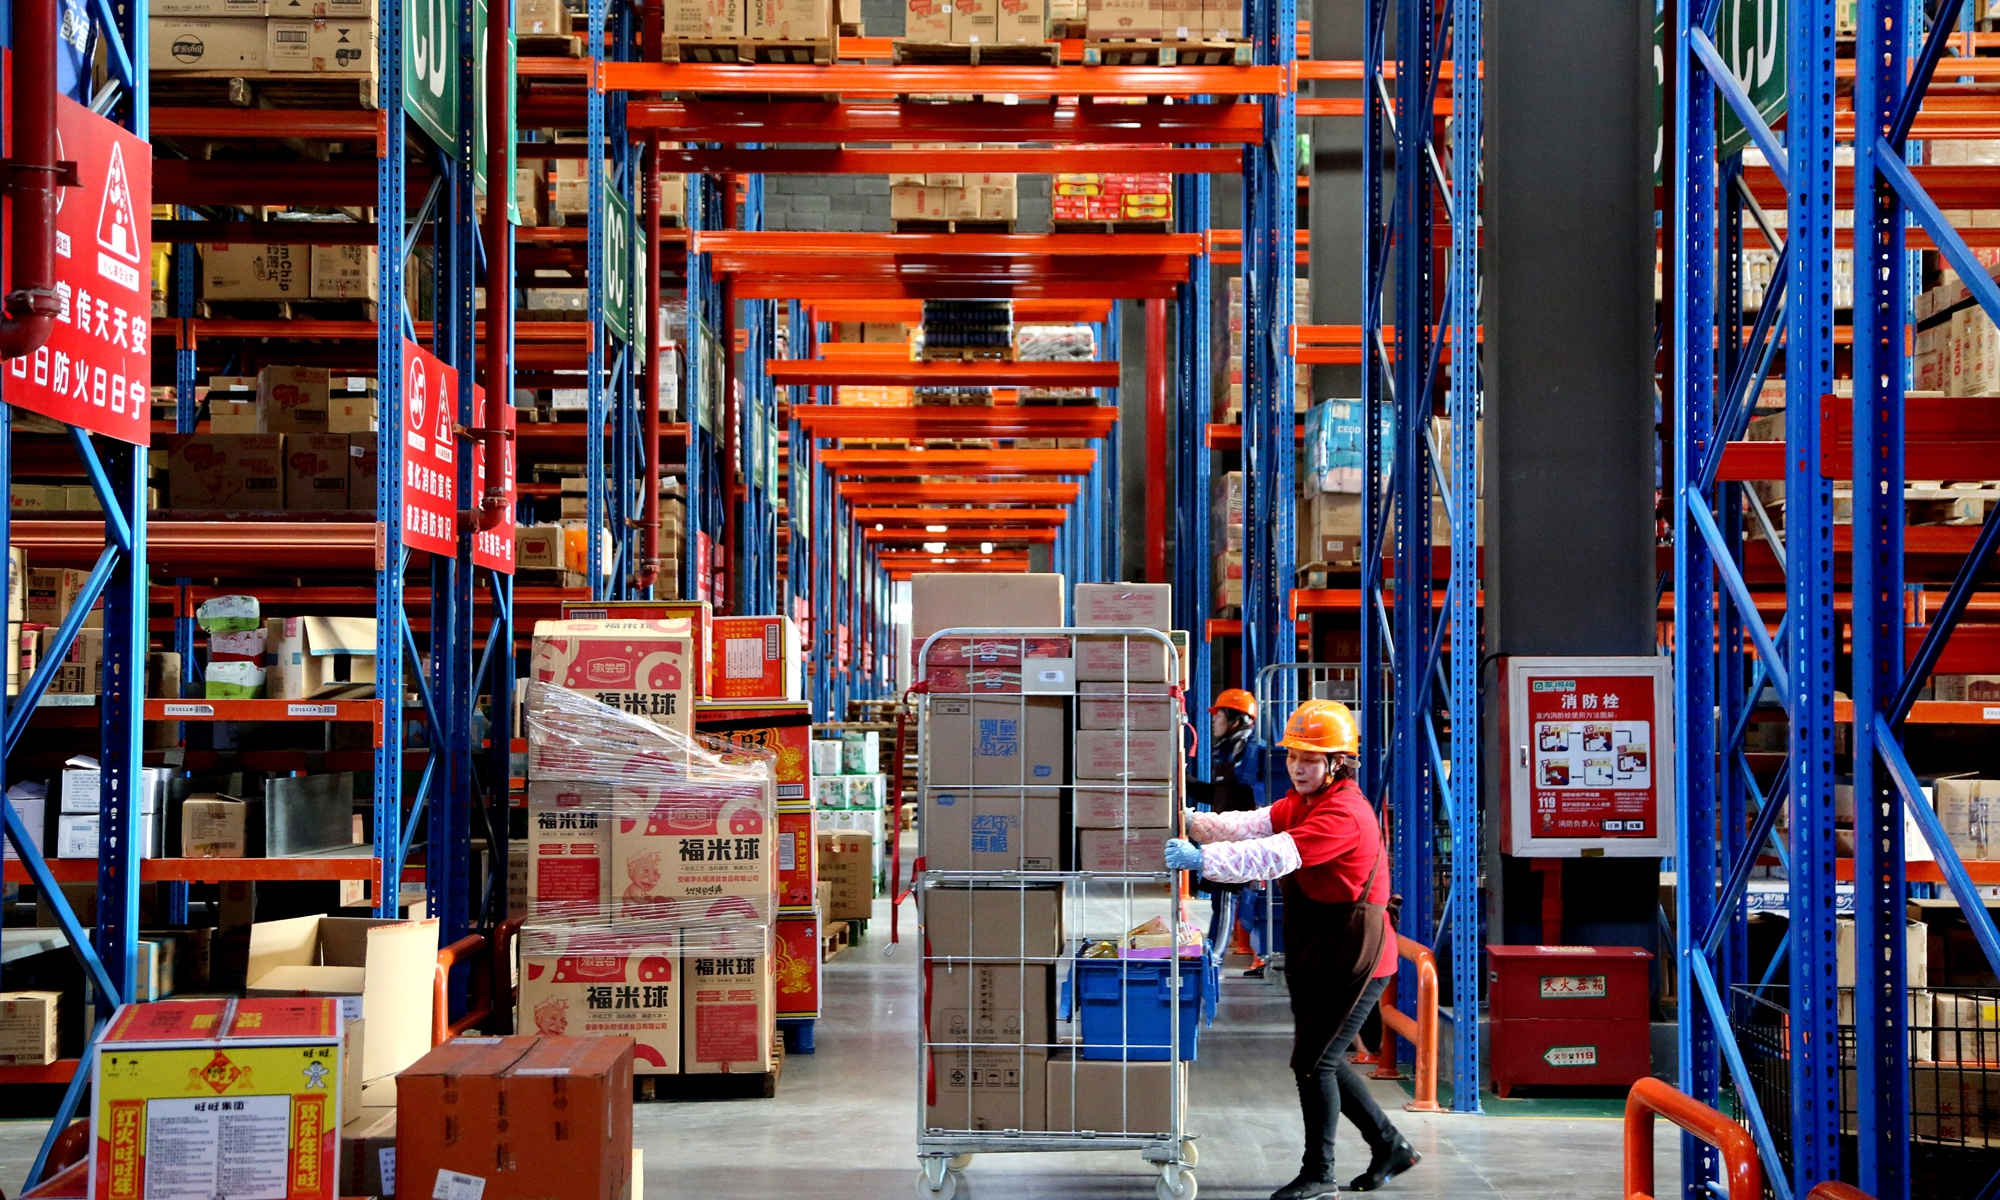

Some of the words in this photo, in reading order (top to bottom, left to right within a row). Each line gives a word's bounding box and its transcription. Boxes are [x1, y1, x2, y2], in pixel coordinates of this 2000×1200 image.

[607, 202, 624, 309] CC
[406, 459, 452, 502] 强化消防宣传
[595, 692, 677, 716] 福米球
[1561, 693, 1620, 710] 消防栓
[1538, 797, 1556, 808] 119
[538, 812, 599, 829] 福米球
[679, 838, 760, 861] 福米球
[695, 958, 755, 975] 福米球
[1543, 978, 1604, 992] 灭火器箱
[587, 985, 668, 1009] 福米球
[194, 1102, 245, 1112] 旺旺集团
[113, 1110, 137, 1195] 红火旺旺年
[297, 1103, 320, 1187] 欢乐年年旺
